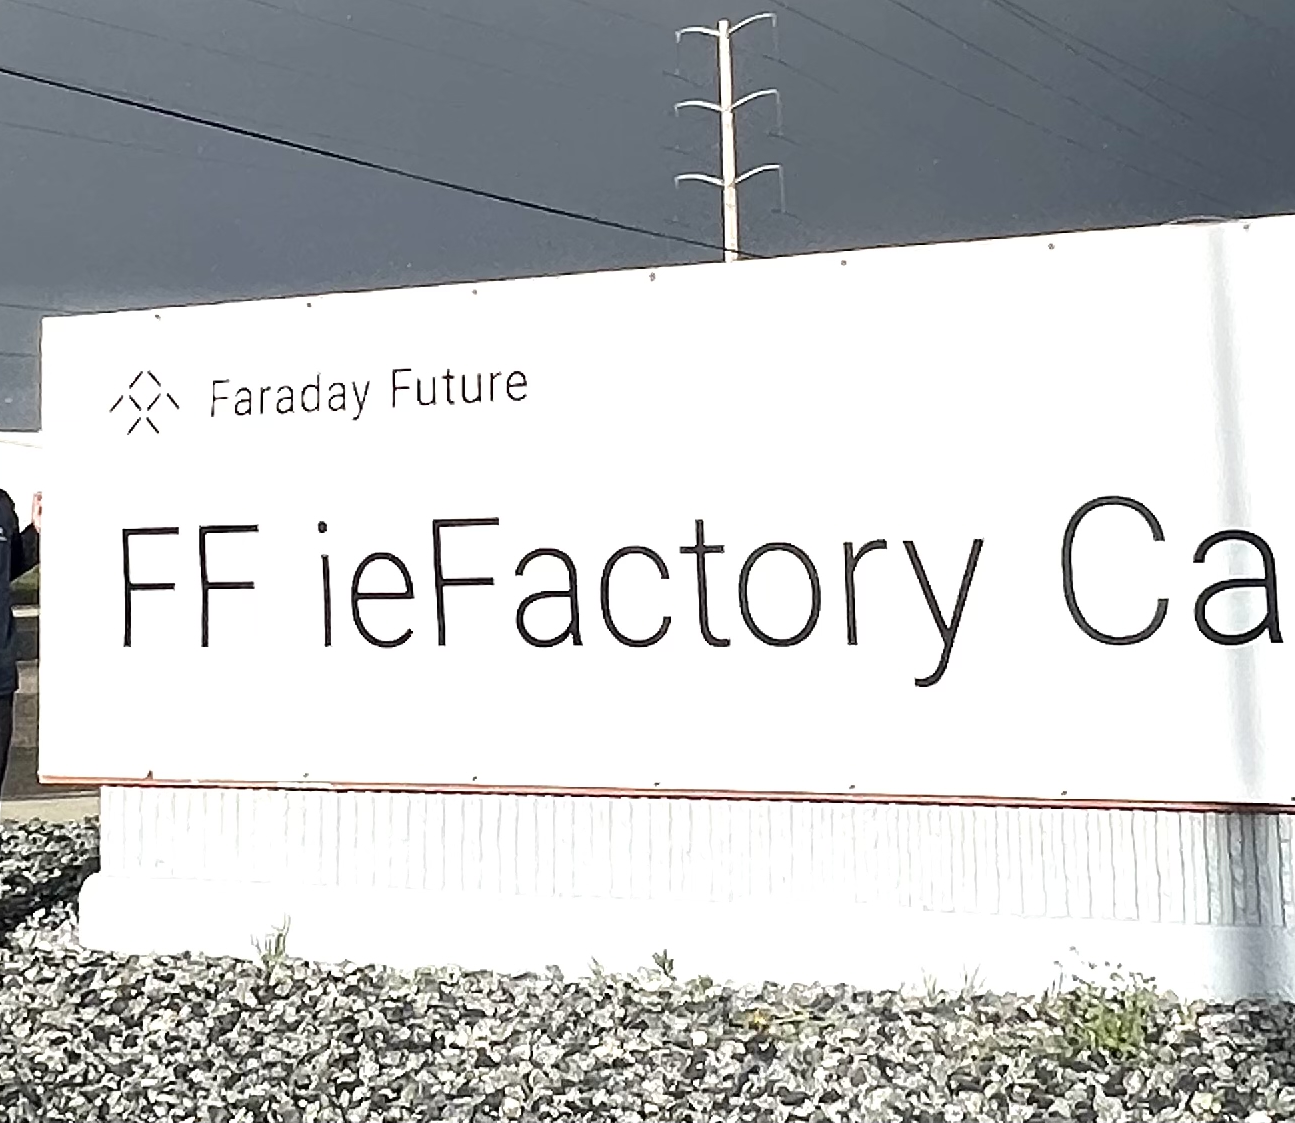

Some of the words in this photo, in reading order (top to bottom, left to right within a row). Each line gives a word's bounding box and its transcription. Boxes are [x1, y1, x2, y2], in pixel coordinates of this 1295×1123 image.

[210, 373, 371, 421] Faraday
[391, 367, 529, 409] Future
[121, 524, 260, 648] FF
[317, 516, 985, 688] ieFactory
